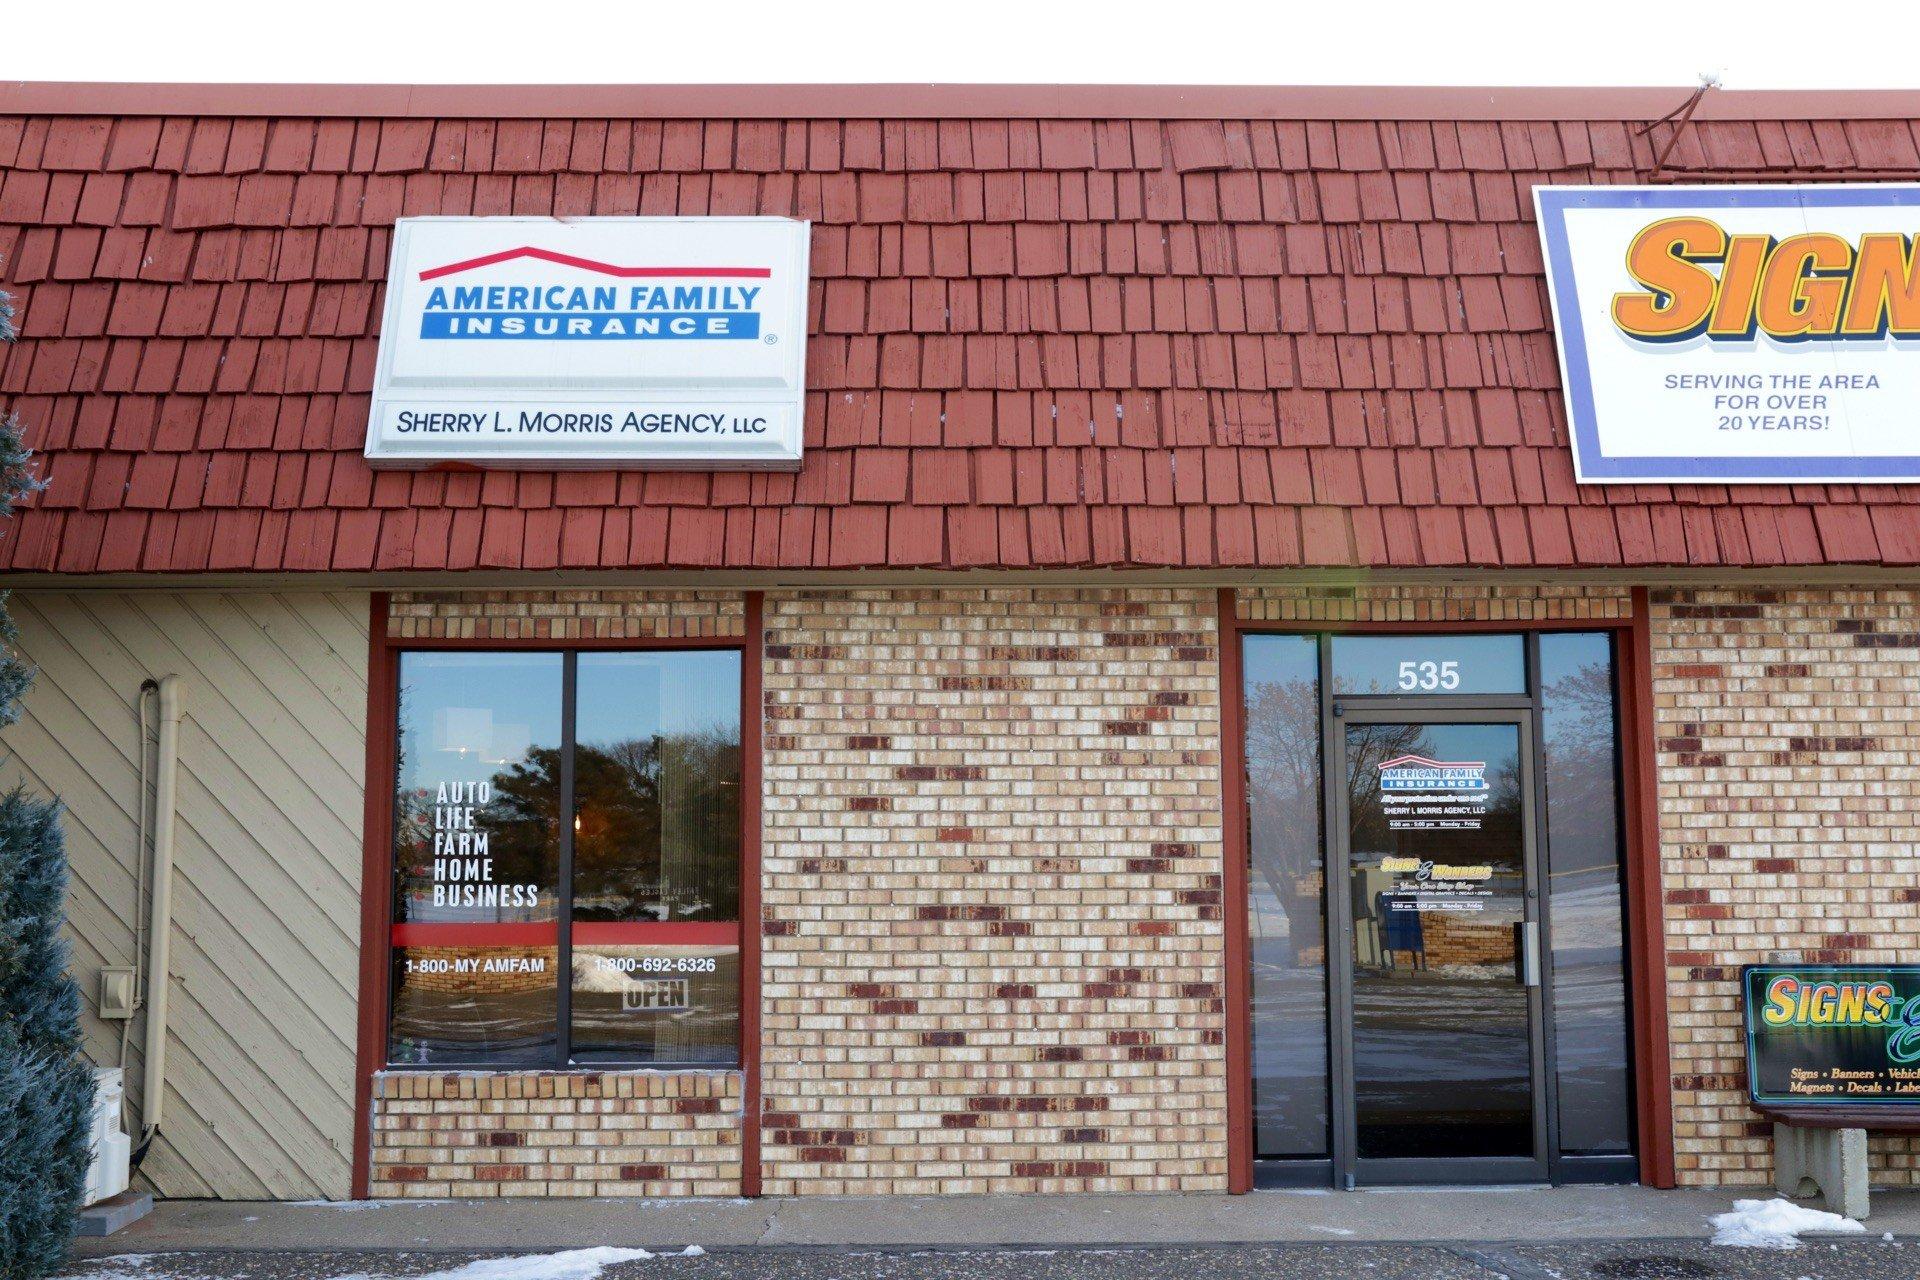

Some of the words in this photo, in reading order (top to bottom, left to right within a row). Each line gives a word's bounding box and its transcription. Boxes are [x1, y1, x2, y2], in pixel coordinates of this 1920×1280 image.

[1611, 216, 1920, 344] SIGN
[425, 285, 617, 311] AMERICAN
[629, 285, 762, 311] FAMILY
[448, 317, 731, 335] INSURANCE
[1664, 374, 1763, 390] SERVING
[1769, 374, 1812, 390] THE
[1818, 374, 1881, 389] AREA
[1714, 394, 1760, 410] FOR
[1766, 394, 1828, 410] OVER
[396, 411, 488, 433] SHERRY
[494, 411, 512, 433] L.
[519, 411, 613, 433] MORRIS
[621, 411, 727, 435] AGENCY,
[733, 417, 767, 434] LLC
[1717, 415, 1743, 431] 20
[1747, 415, 1830, 431] YEARS!
[1398, 661, 1460, 690] 535
[1382, 768, 1440, 779] AMERICAN
[1442, 768, 1485, 779] FAMILY
[436, 780, 490, 804] AUTO
[435, 806, 474, 830] LIFE
[1383, 807, 1410, 815] SHERRY
[1417, 807, 1443, 815] MORRIS
[434, 832, 489, 855] FARM
[433, 858, 493, 881] HOME
[432, 884, 538, 908] BUSINESS
[405, 958, 479, 973] 1-800-MY
[482, 958, 545, 973] AMFAM
[595, 957, 716, 973] 1-800-692-6326
[627, 980, 685, 1008] OPEN
[1762, 975, 1893, 1026] SIGNS
[1790, 1068, 1818, 1081] Signs
[1831, 1068, 1875, 1079] Banners
[1789, 1082, 1834, 1094] Magnets
[1847, 1082, 1882, 1093] Decals
